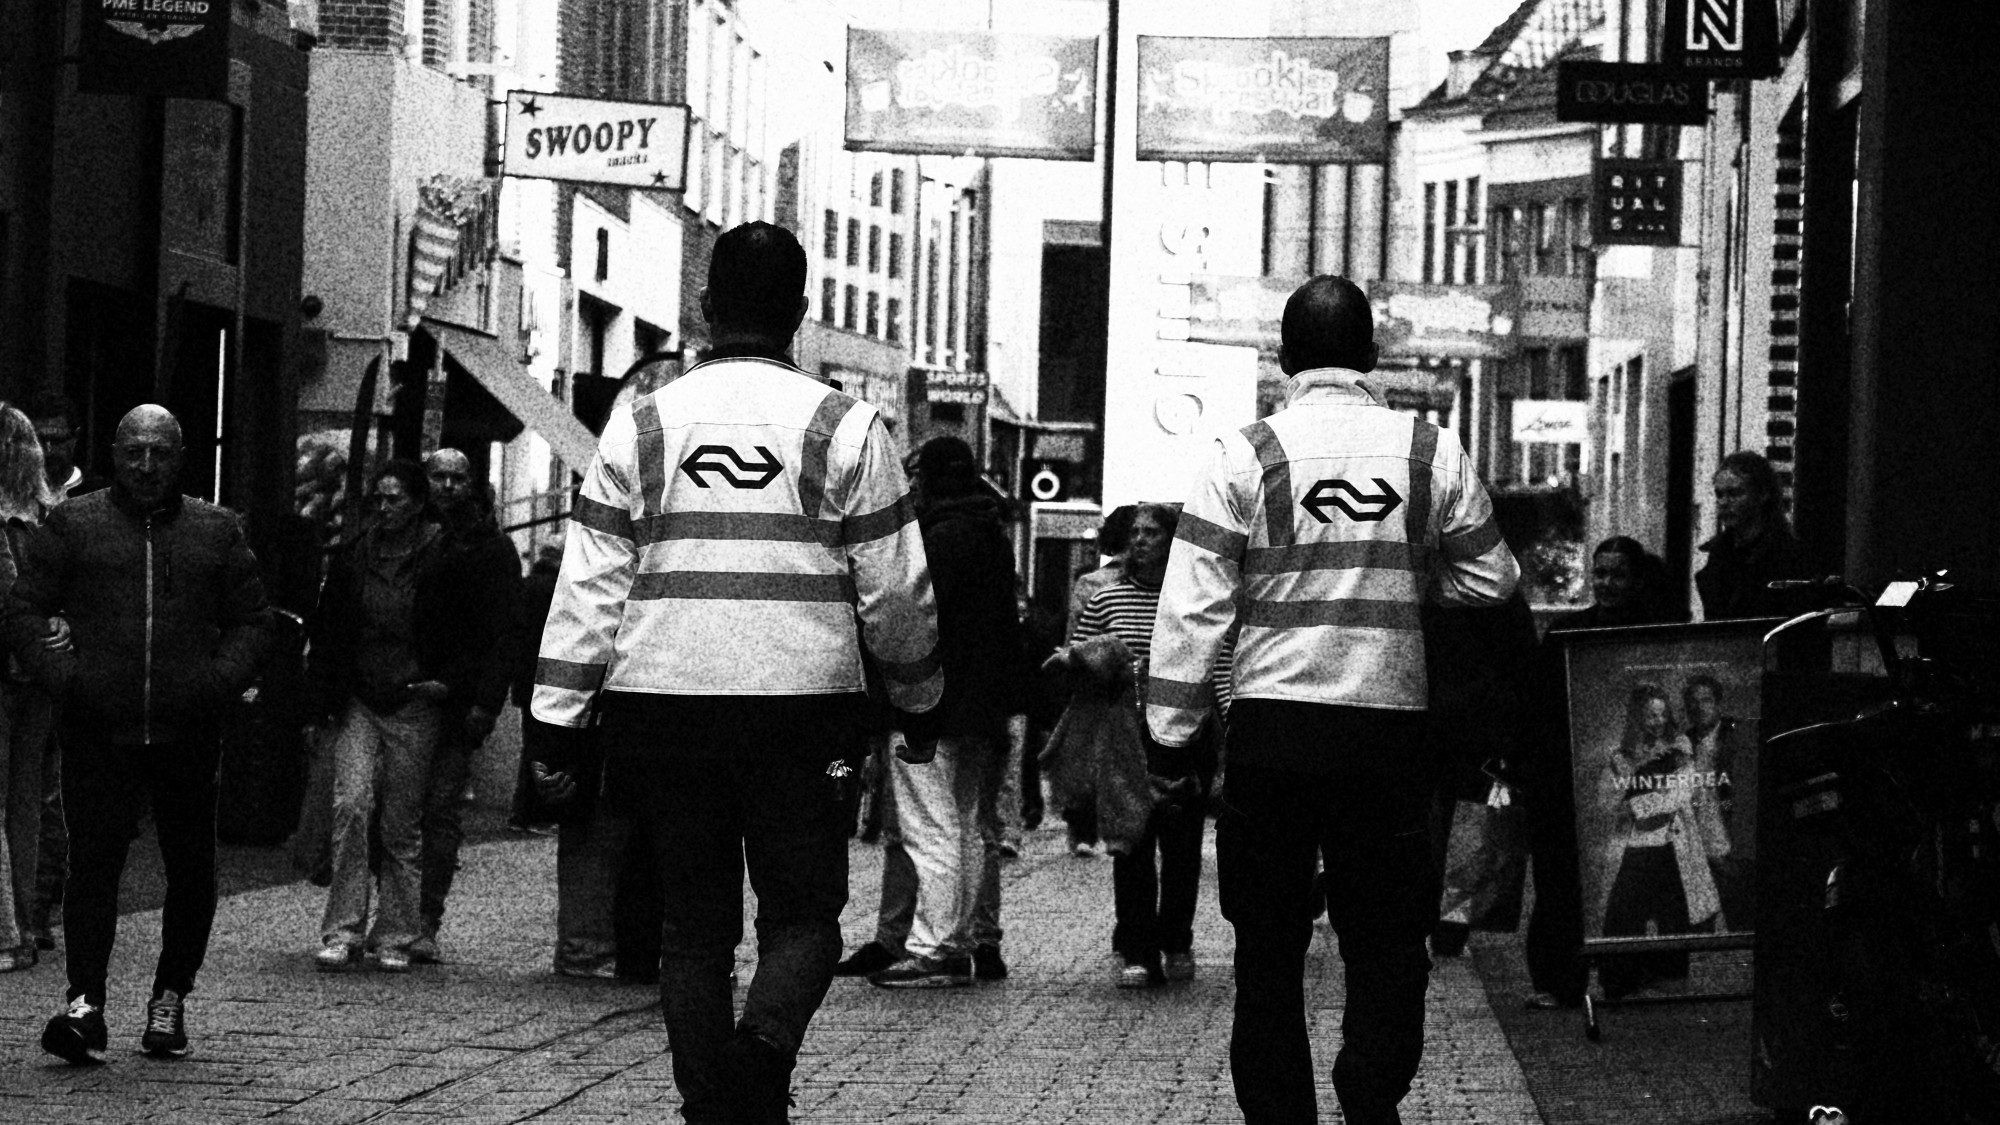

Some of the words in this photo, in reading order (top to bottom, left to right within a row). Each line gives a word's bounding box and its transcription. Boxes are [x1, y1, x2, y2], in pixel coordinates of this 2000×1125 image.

[102, 0, 137, 10] PME
[142, 0, 210, 14] LEGEND
[1685, 57, 1743, 67] BRANDS
[1576, 80, 1690, 104] DOUGLAS
[526, 117, 657, 160] SWOOPY
[927, 389, 985, 404] WORLD
